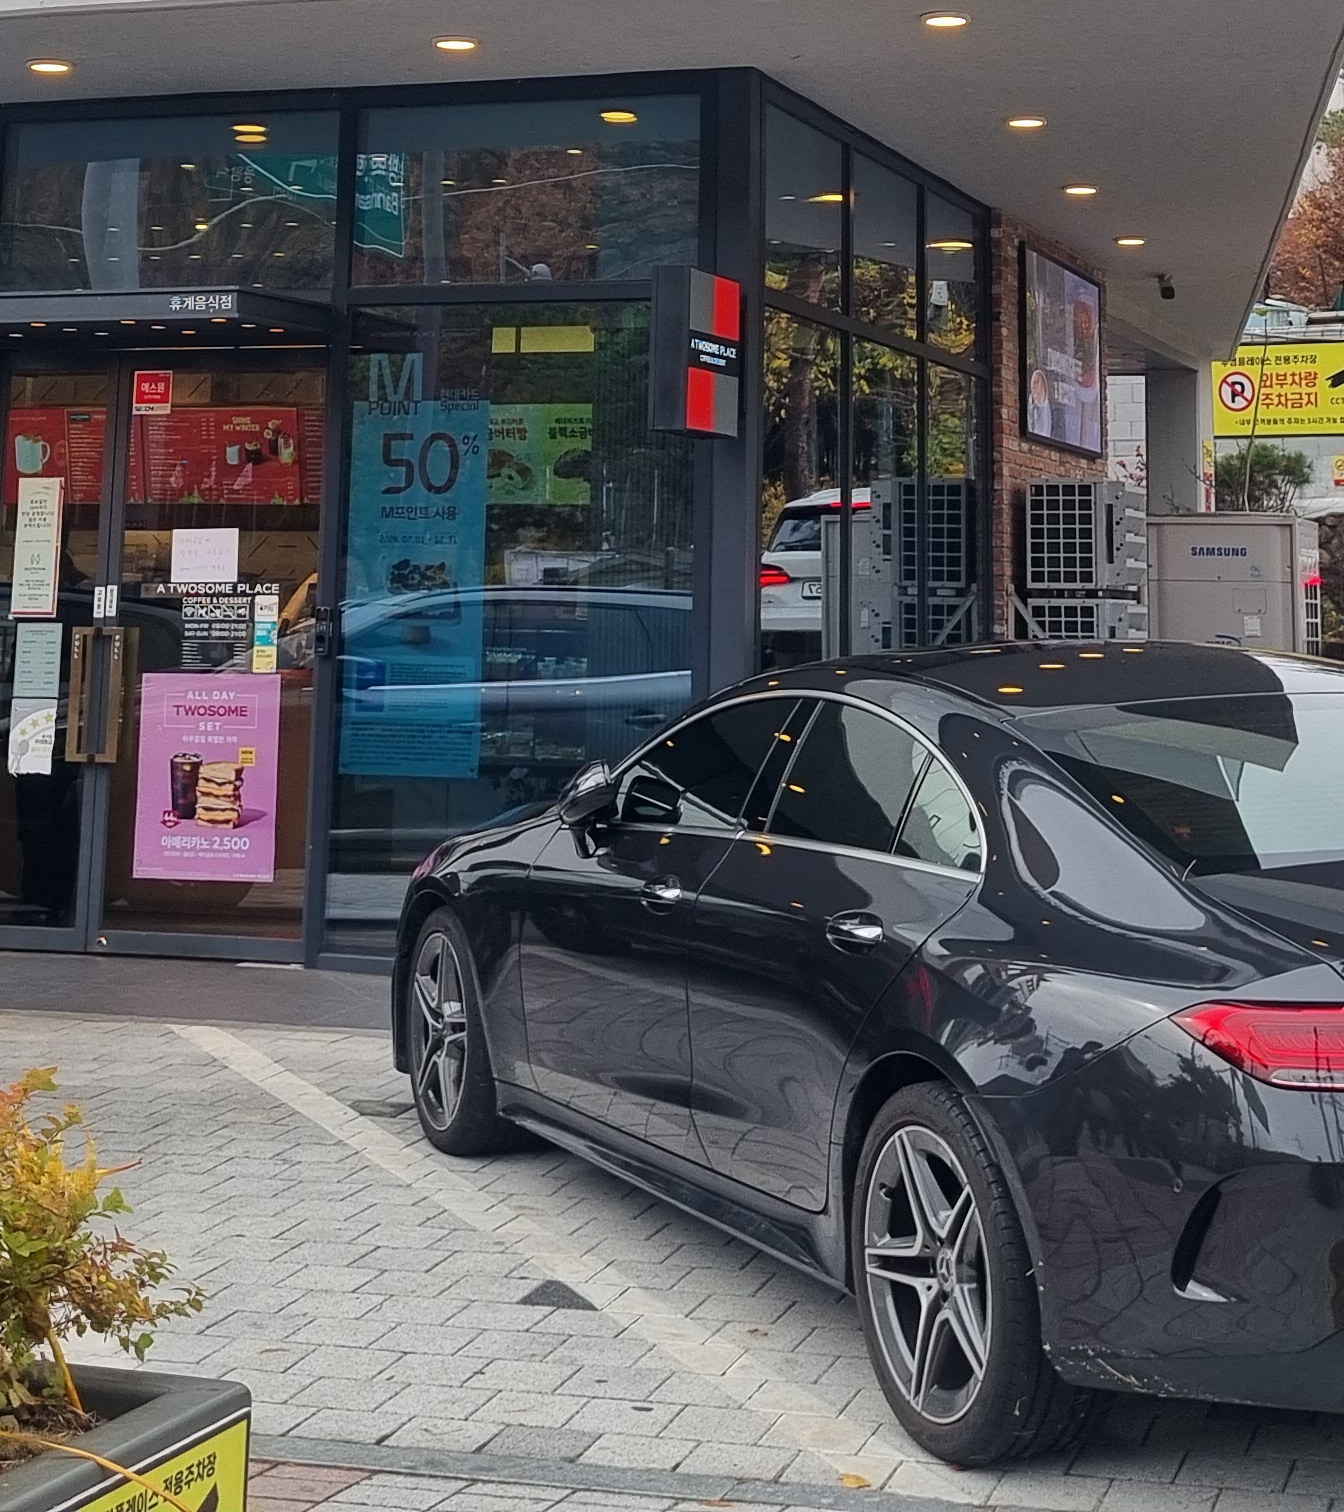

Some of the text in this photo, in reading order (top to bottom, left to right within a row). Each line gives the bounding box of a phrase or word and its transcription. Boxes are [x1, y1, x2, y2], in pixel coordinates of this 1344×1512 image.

[168, 294, 233, 312] 휴게음식점
[1274, 354, 1317, 366] 전용주차장
[1260, 371, 1318, 389] 외부차량
[140, 381, 165, 394] 에스원
[439, 400, 480, 413] Special
[1261, 392, 1318, 409] 주차금지
[367, 401, 421, 416] POINT
[381, 505, 458, 521] M포인트 사용
[1190, 546, 1247, 557] SAMSUNG
[156, 584, 280, 594] A TWOSOME PLACE
[182, 596, 212, 604] COFFEE
[219, 596, 252, 605] DESSERT
[113, 634, 121, 660] PULL
[186, 690, 236, 700] ALL DAY
[173, 704, 249, 717] TWOSOME
[197, 721, 222, 731] SET
[160, 834, 251, 851] 아메리카노 2,500
